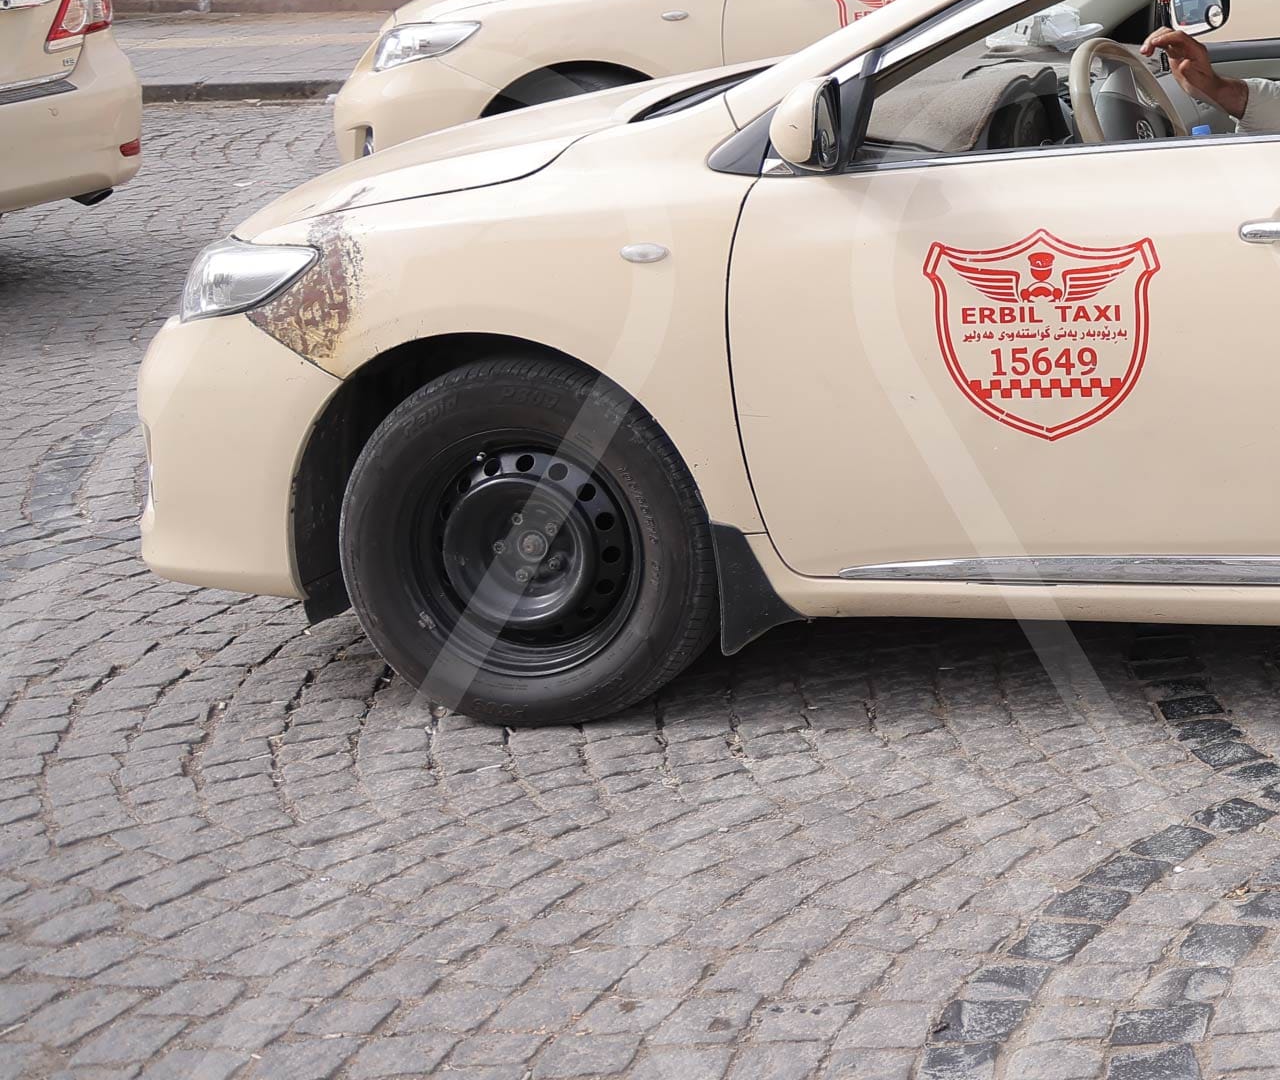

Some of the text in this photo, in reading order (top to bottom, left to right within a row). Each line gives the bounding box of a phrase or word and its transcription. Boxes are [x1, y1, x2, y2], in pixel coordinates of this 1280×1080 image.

[961, 304, 1121, 324] ERBIL TAXI
[990, 346, 1098, 377] 15649
